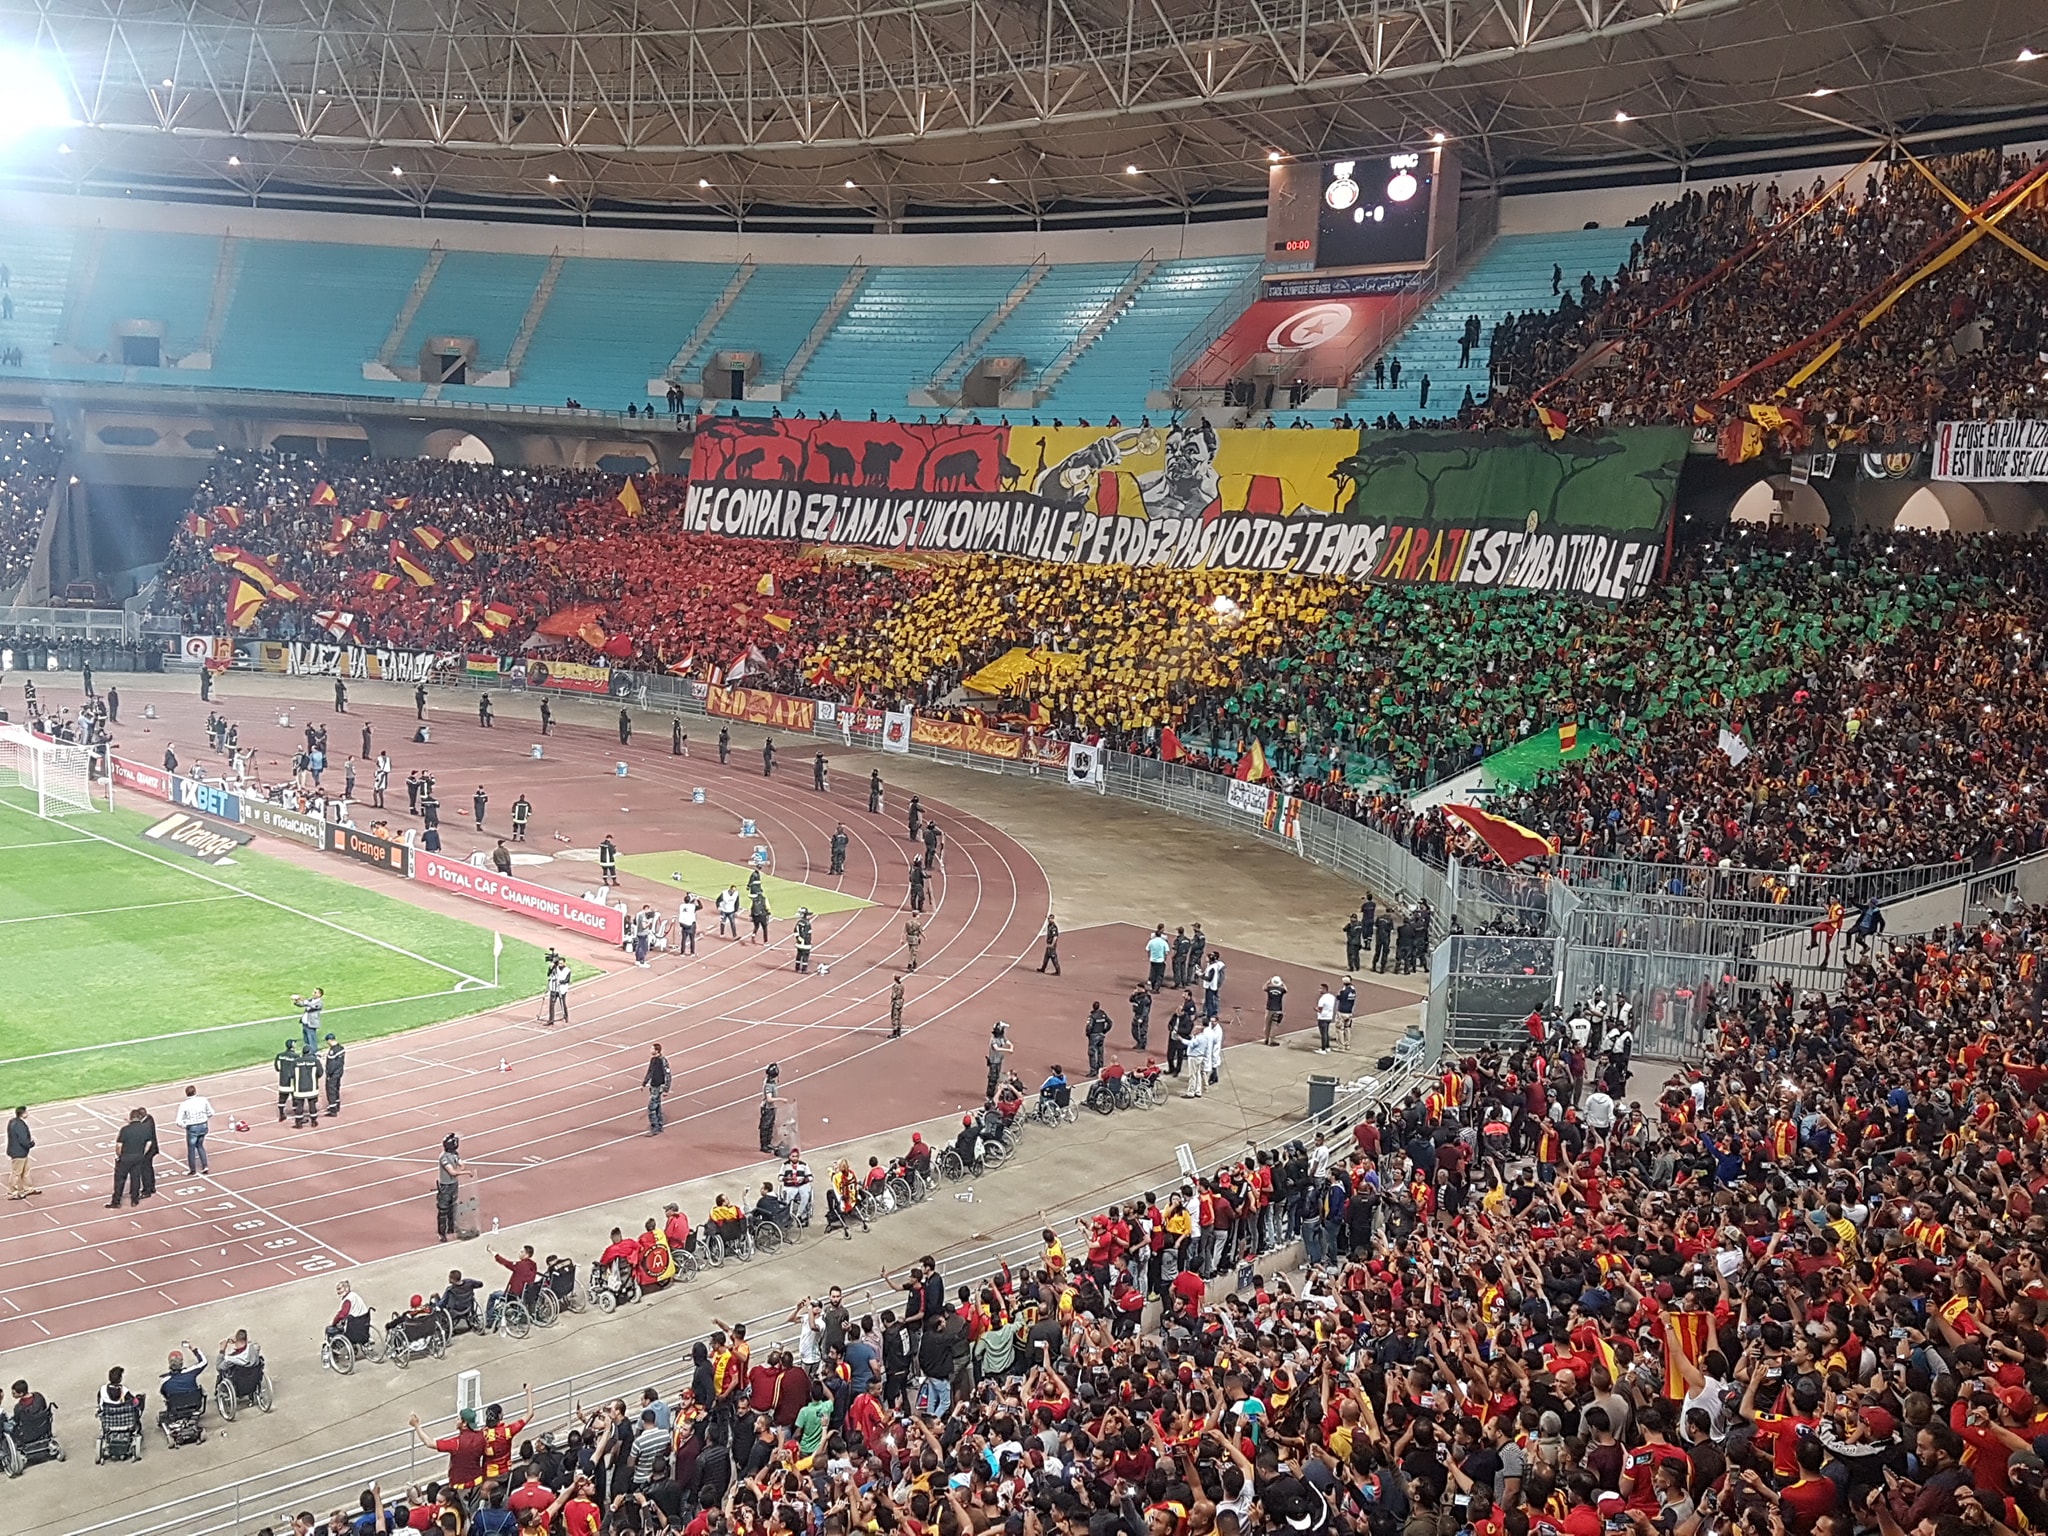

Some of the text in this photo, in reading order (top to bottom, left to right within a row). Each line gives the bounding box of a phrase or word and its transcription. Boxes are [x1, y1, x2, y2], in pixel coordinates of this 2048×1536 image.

[1286, 240, 1310, 250] 00:00
[1987, 424, 2001, 447] EN
[2000, 421, 2026, 448] PAIX
[683, 485, 713, 531] NE
[709, 487, 838, 541] COMPAREZ
[829, 497, 913, 547] JAMAIS
[1074, 512, 1181, 567] PERDEZ
[1167, 516, 1217, 569] PAS
[1206, 517, 1303, 571] VOTRE
[1291, 522, 1386, 581] TEMPS
[1372, 525, 1470, 582] TARAJI
[1459, 527, 1523, 585] EST
[286, 641, 342, 676] ALLEZ
[115, 764, 135, 780] TOTAL
[180, 778, 229, 817] 1XBET
[171, 820, 238, 857] Orange
[273, 813, 319, 839] #TotalCAFCL
[350, 835, 386, 862] Orange
[436, 863, 607, 930] TOTAL CAF CHAMPIONS LEAGUE
